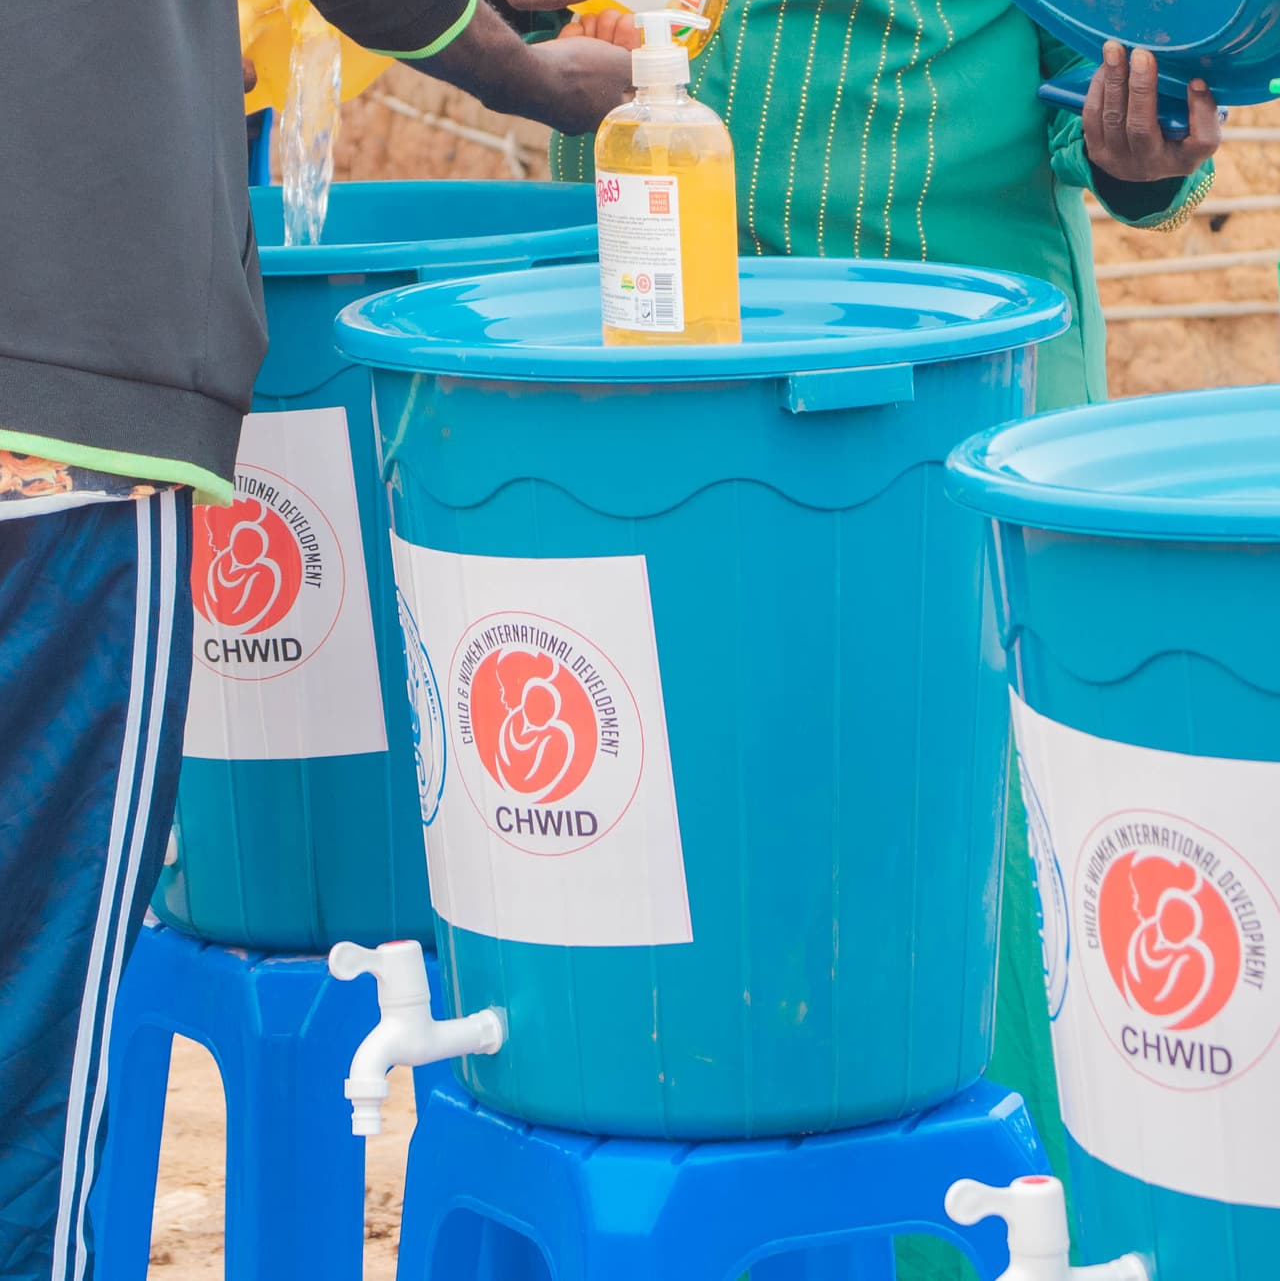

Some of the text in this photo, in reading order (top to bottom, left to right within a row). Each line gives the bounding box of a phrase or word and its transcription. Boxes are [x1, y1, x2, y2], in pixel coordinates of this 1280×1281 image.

[278, 499, 322, 588] DEVELOPMENT
[204, 638, 302, 662] CHWID
[457, 624, 619, 758] CHILD & WOMEN INTERNATIONAL DEVELOPMENT
[495, 806, 598, 837] CHWID
[1083, 823, 1267, 990] CHILD & WOMEN INTERNATIONAL DEVELOPMENT
[1121, 1025, 1232, 1075] CHWID
